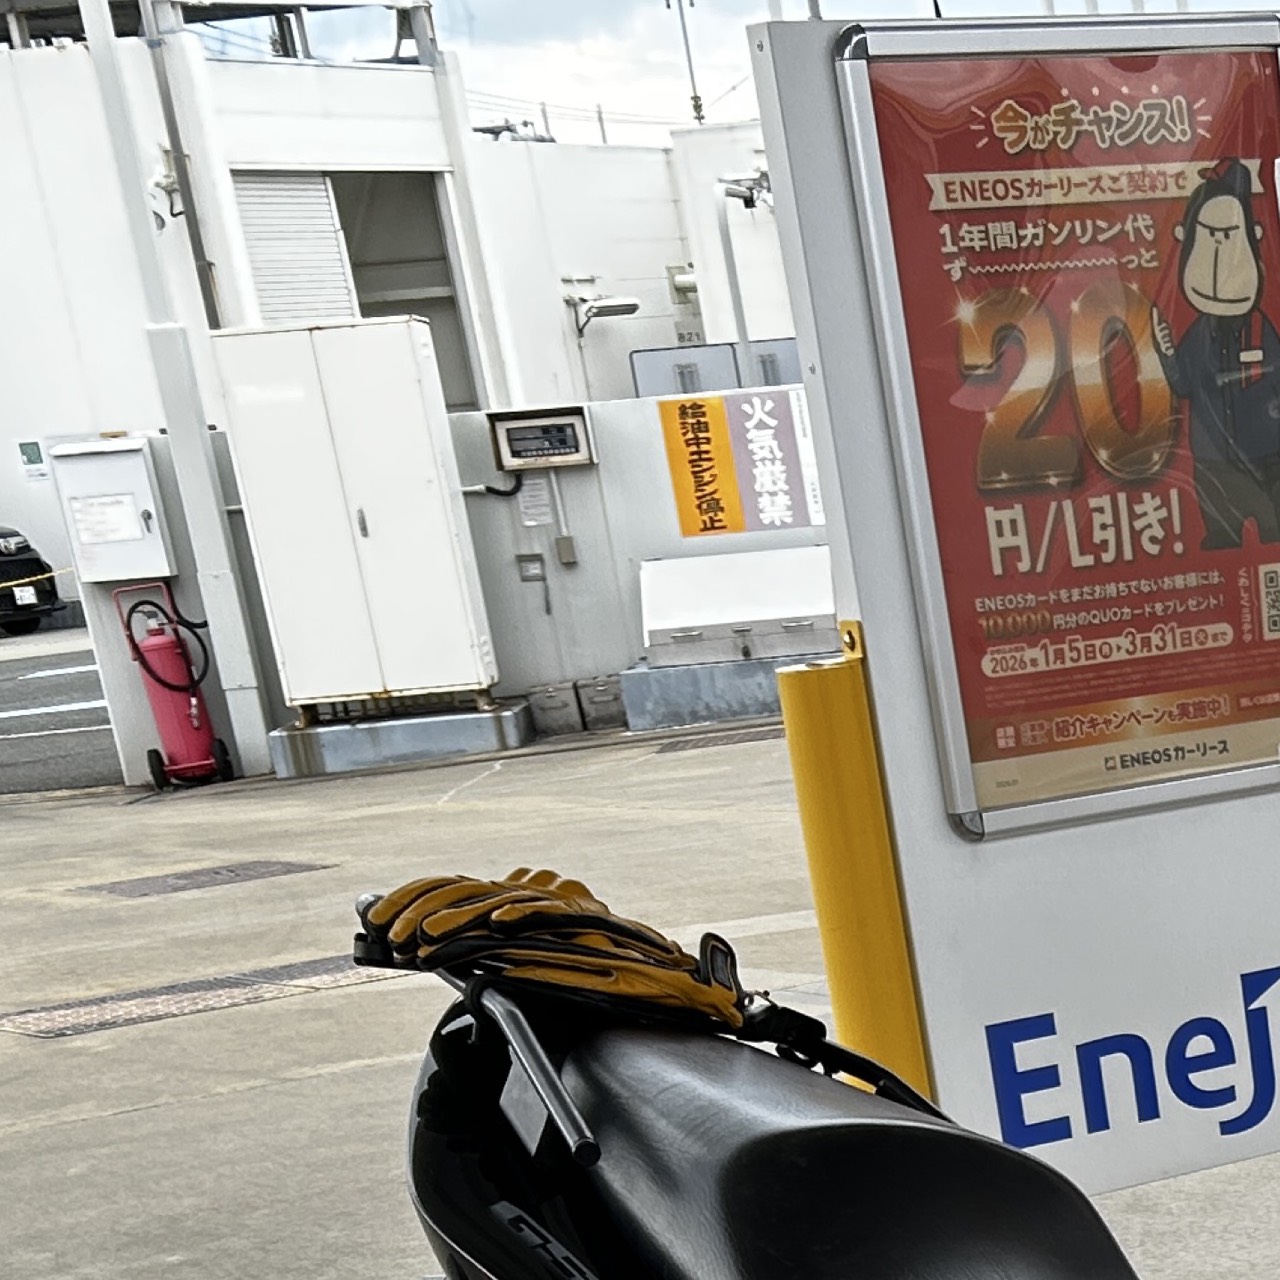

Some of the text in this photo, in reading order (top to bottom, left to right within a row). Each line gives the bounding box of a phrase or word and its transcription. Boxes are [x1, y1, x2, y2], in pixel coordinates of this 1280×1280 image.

[991, 95, 1192, 155] 今がチャンス!
[943, 170, 1187, 204] ENEOSカーリースご契約で
[939, 213, 1156, 254] 1年間ガソリン代
[955, 282, 1180, 495] 20
[678, 402, 728, 532] 給油中エンジン停止
[741, 396, 794, 526] 火気厳禁
[984, 487, 1184, 576] 円/L引き!
[1119, 740, 1231, 770] ENEOSカーリース
